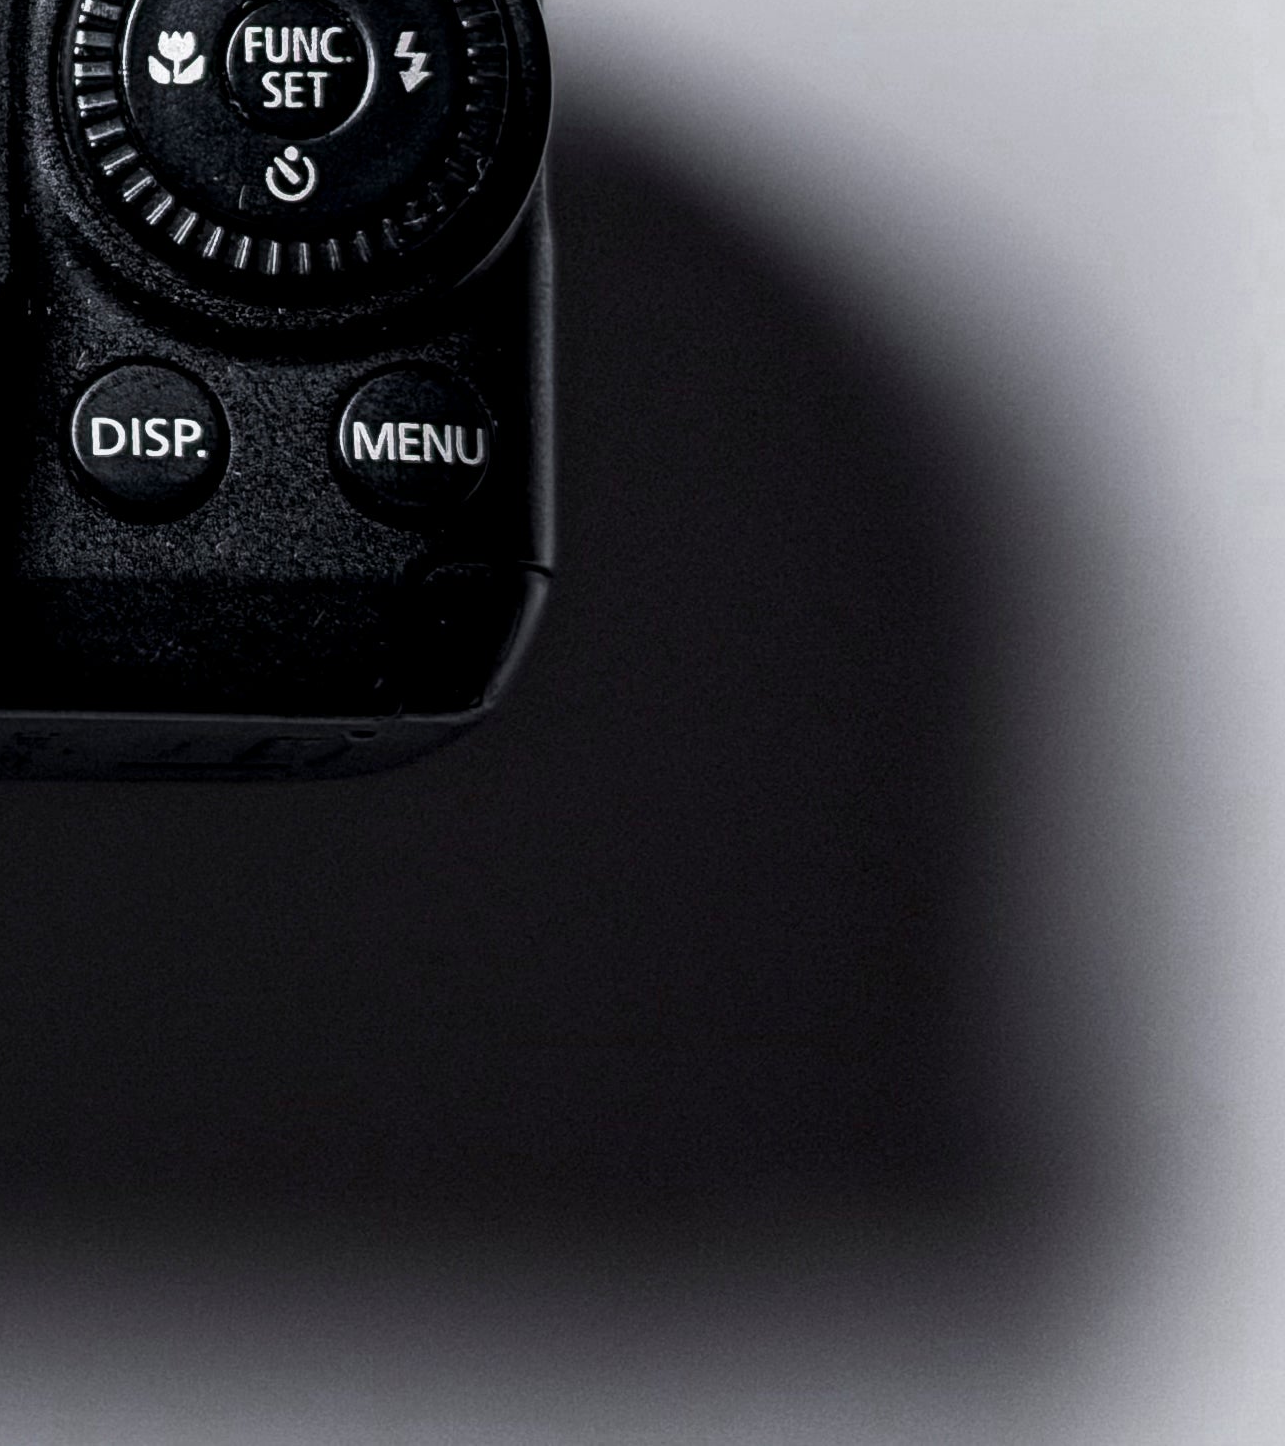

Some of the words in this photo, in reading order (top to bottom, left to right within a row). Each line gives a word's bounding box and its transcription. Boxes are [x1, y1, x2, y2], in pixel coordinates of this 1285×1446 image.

[244, 26, 352, 64] FUNC.
[261, 71, 329, 109] SET
[91, 417, 207, 458] DISP.
[352, 421, 483, 466] MENU
